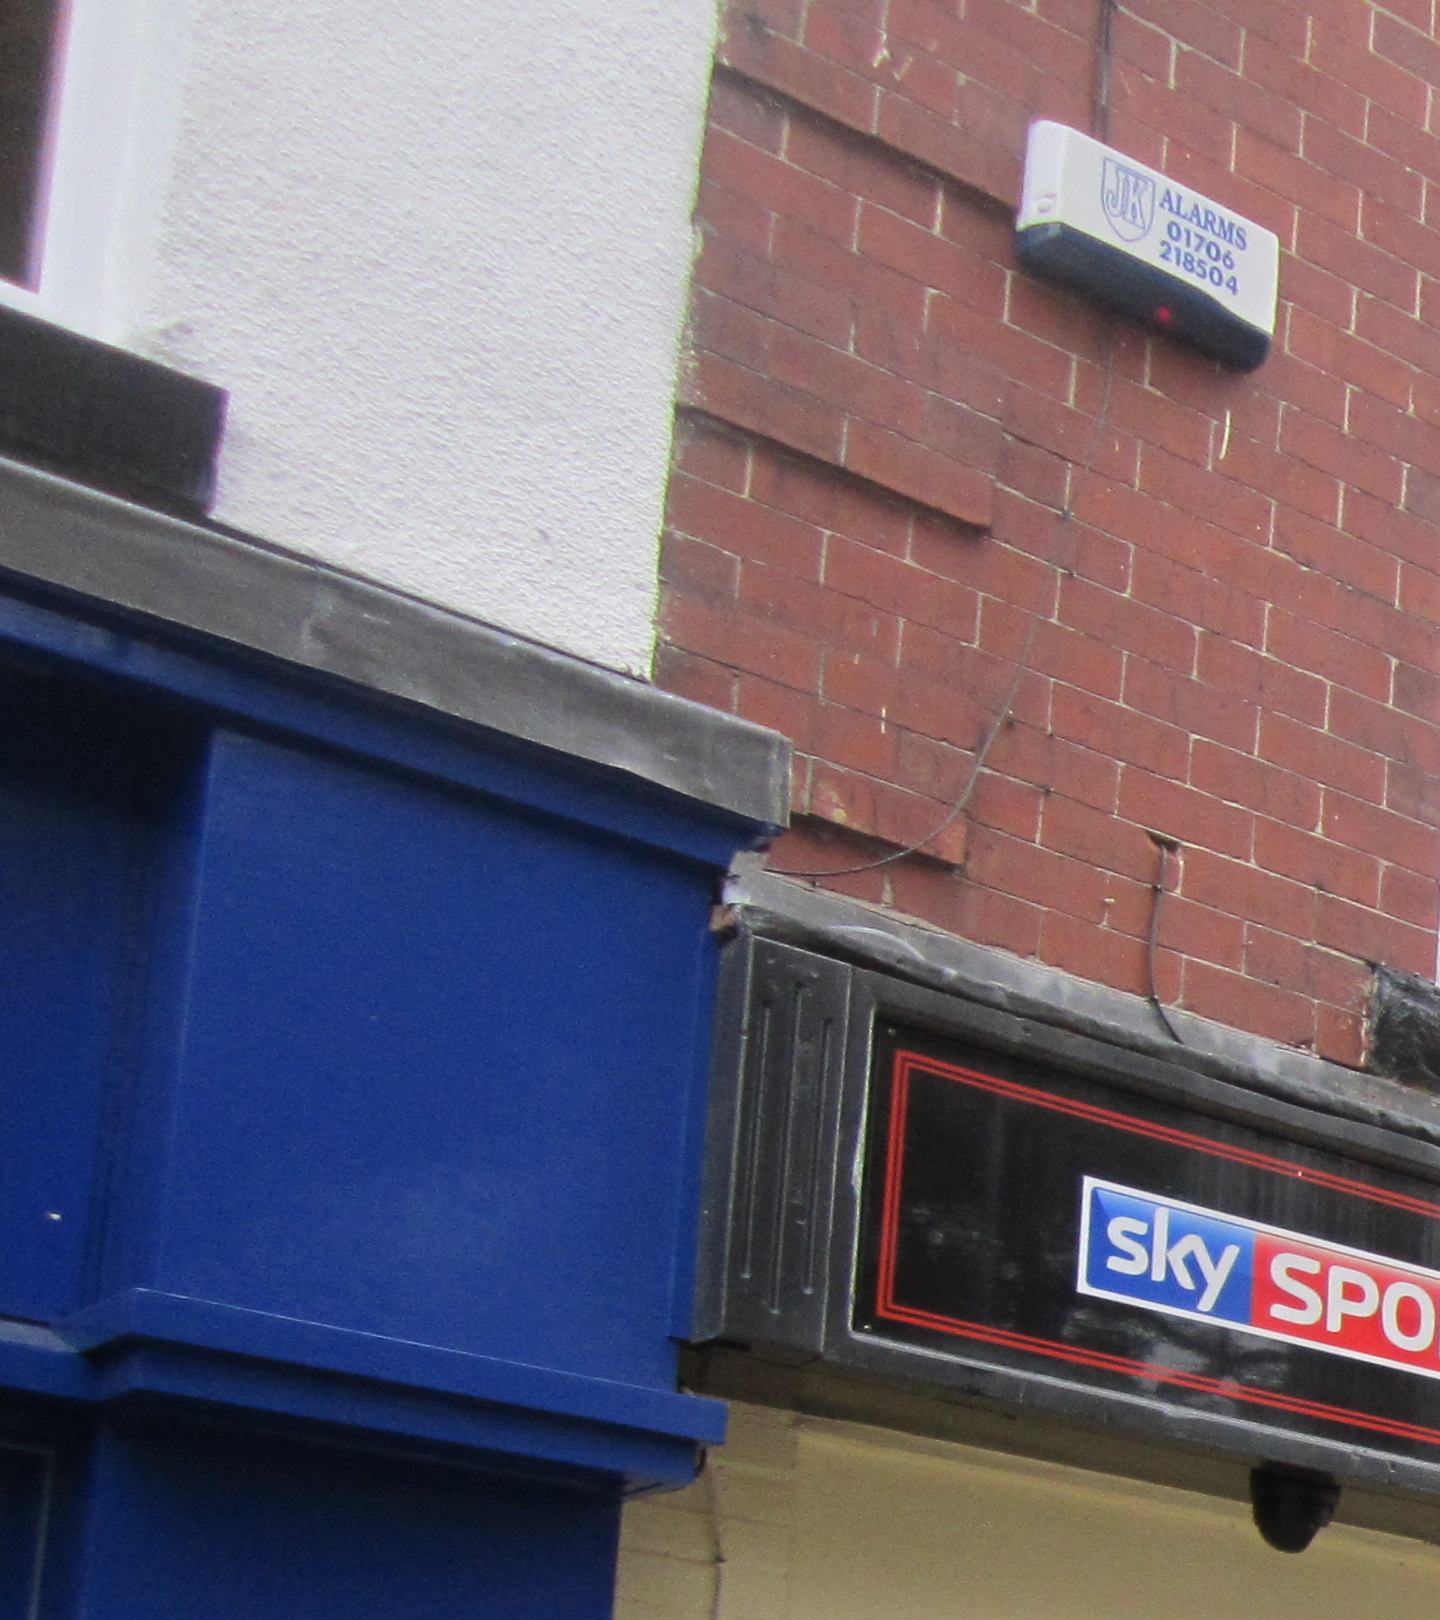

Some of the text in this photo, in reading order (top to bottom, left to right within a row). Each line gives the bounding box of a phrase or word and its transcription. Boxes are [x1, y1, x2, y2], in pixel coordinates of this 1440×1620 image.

[1159, 188, 1248, 252] ALARMS
[1166, 220, 1236, 271] 01706
[1159, 240, 1240, 297] 218504
[1106, 1206, 1241, 1313] sky
